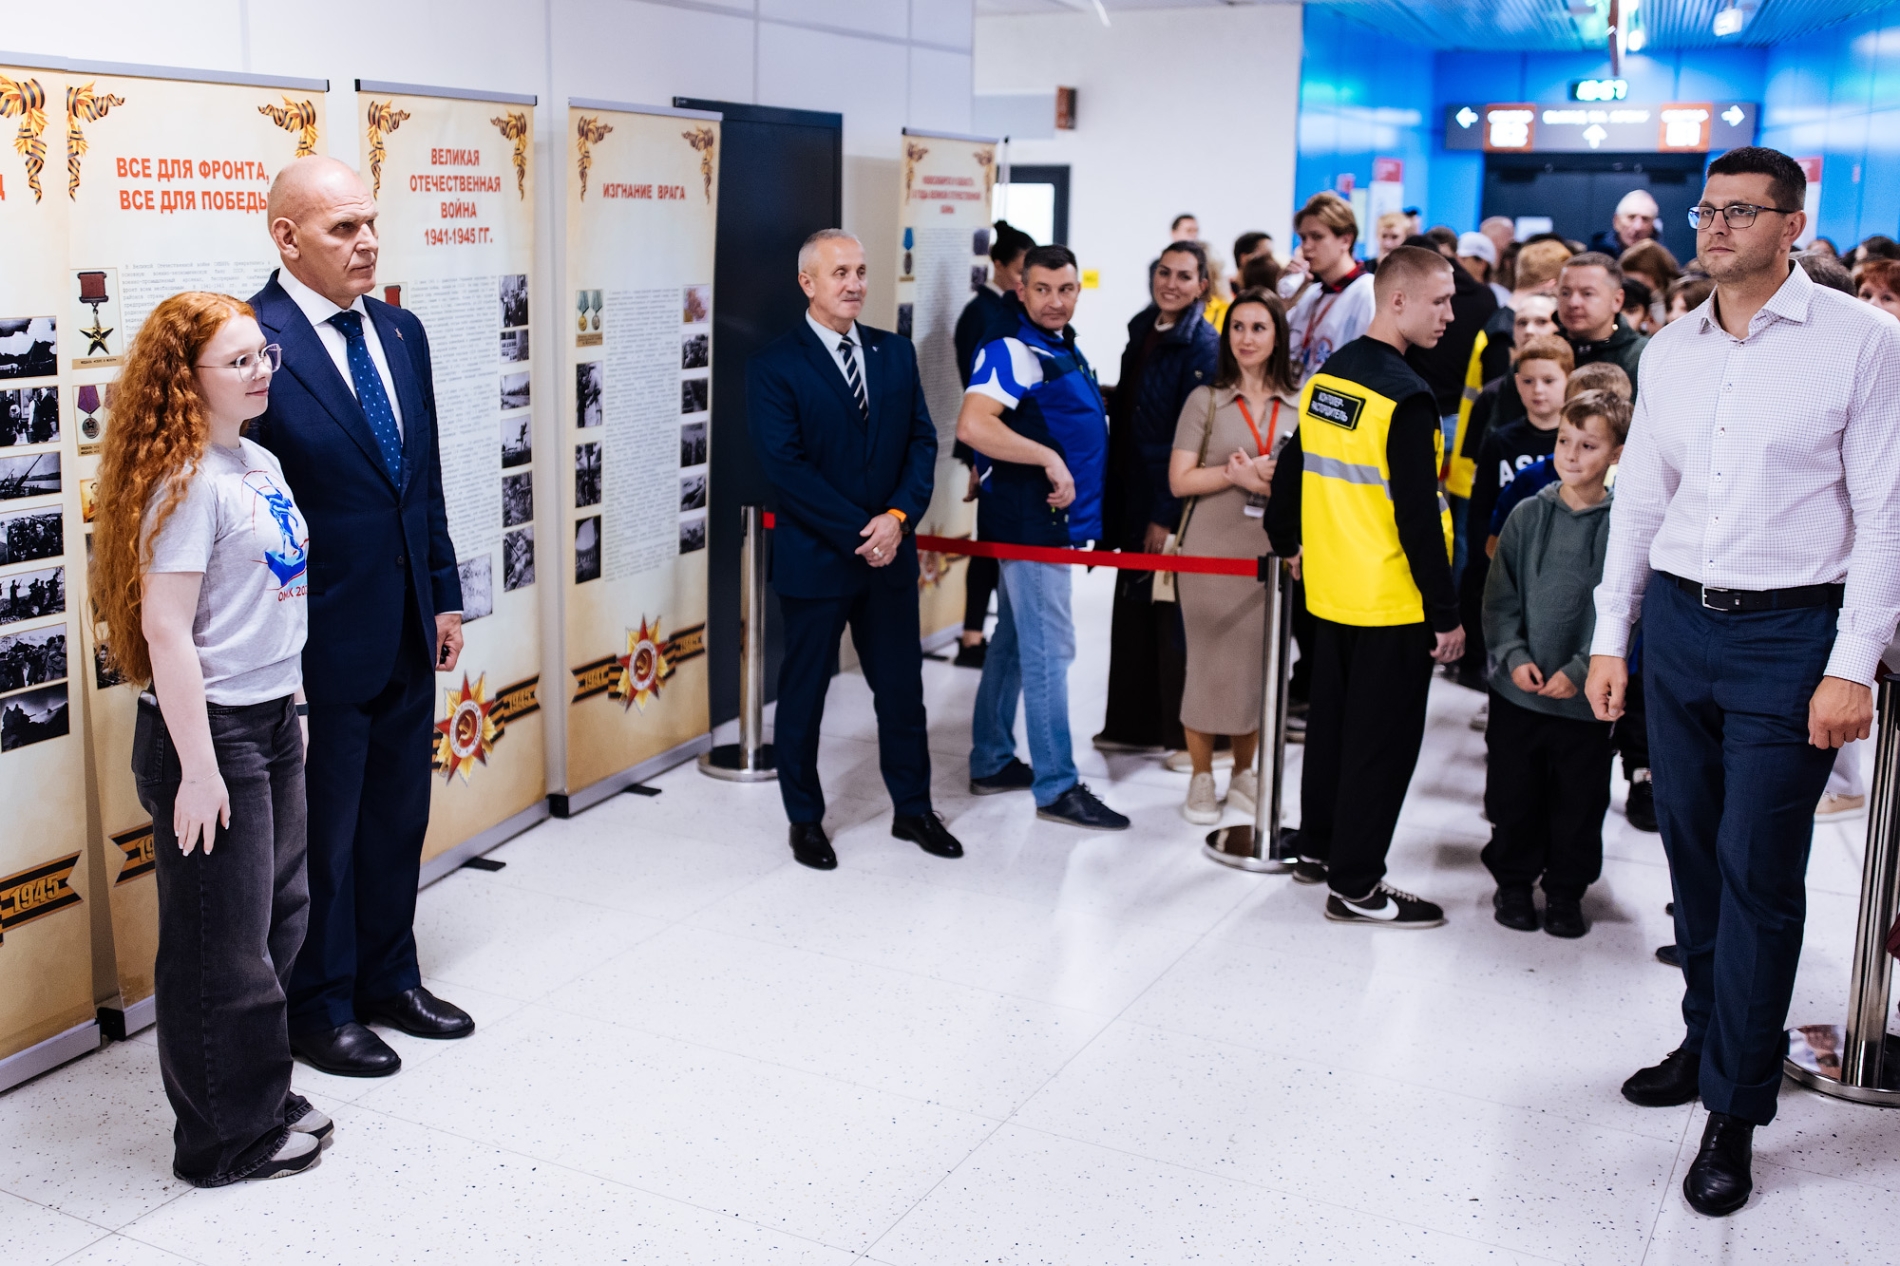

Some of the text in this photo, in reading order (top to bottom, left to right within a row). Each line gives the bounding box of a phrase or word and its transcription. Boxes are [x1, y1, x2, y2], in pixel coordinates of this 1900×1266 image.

[430, 148, 480, 167] ВЕЛИКАЯ
[116, 157, 270, 185] ВСЕ ДЛЯ ФРОНТА,
[409, 174, 502, 194] ОТЕЧЕСТВЕННАЯ
[602, 183, 686, 201] ИЗГНАНИЕ ВРАГА
[119, 190, 155, 210] ВСЕ
[160, 191, 196, 214] ДЛЯ
[440, 197, 478, 220] ВОЙНА
[424, 227, 494, 246] 1941-1945 ГГ.
[1499, 454, 1546, 488] AS
[10, 874, 60, 913] 1945
